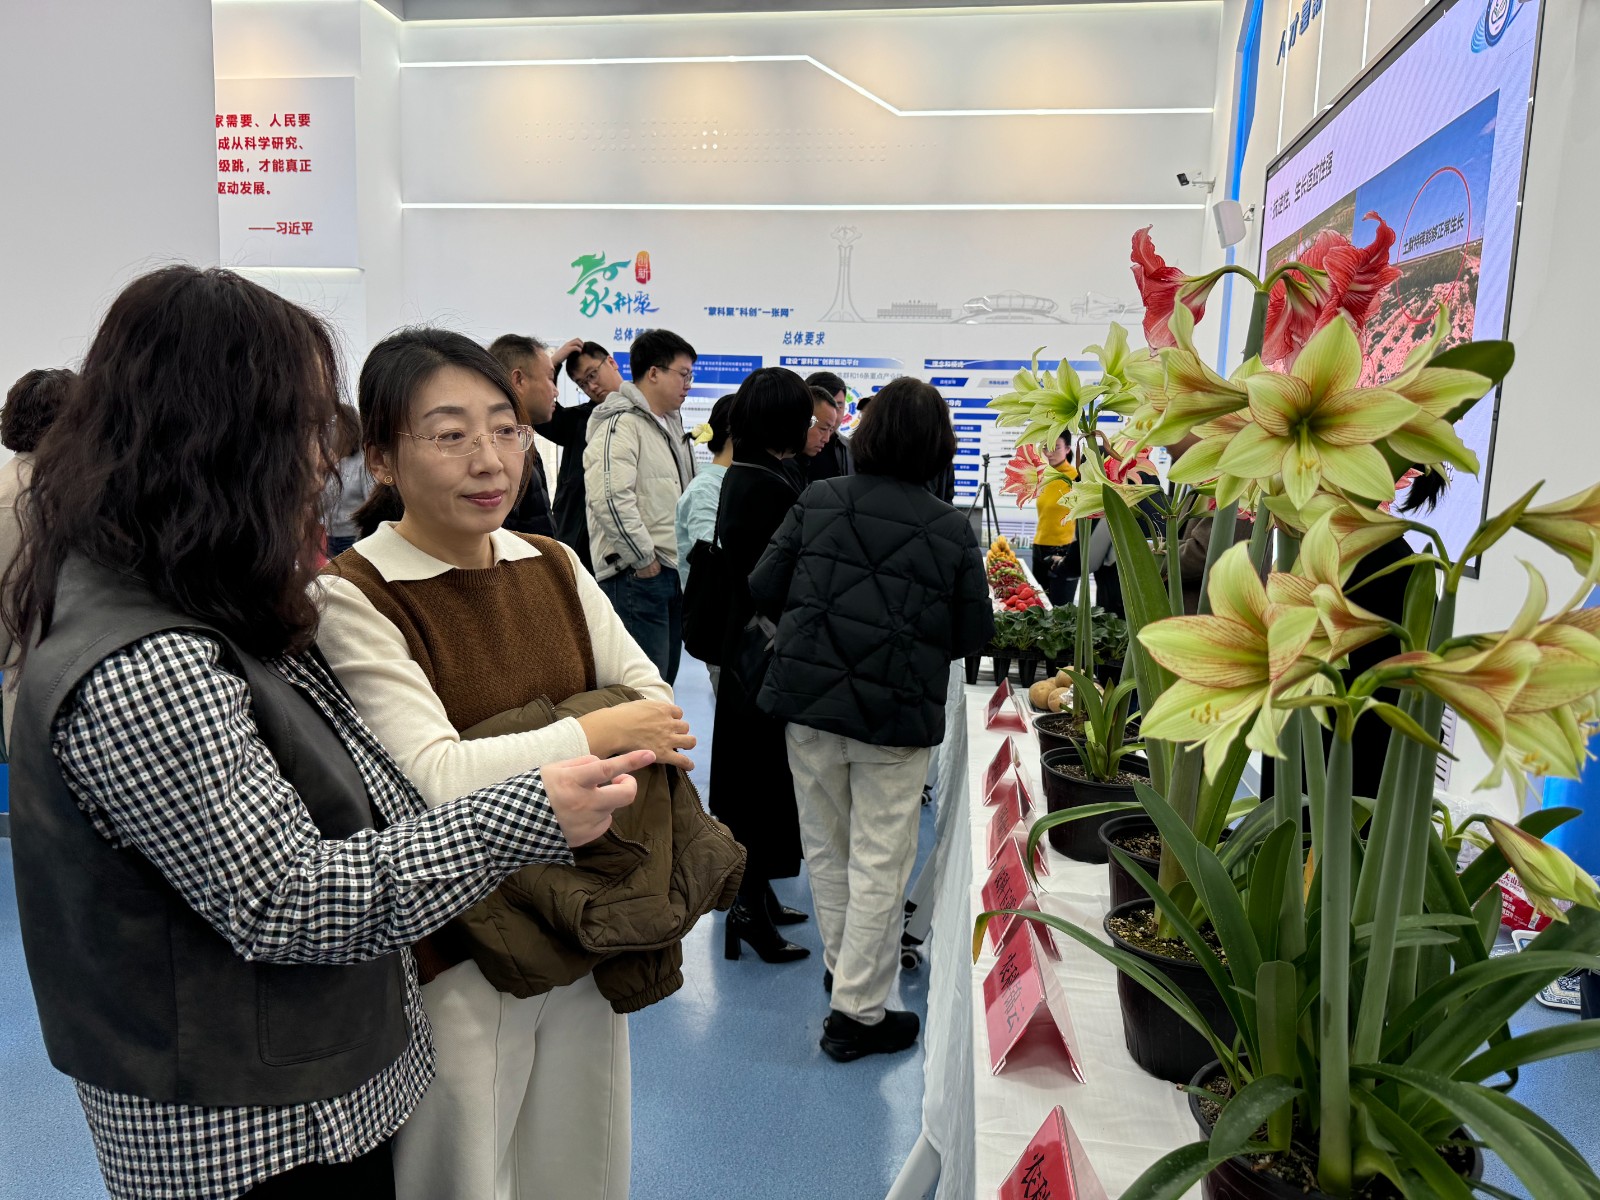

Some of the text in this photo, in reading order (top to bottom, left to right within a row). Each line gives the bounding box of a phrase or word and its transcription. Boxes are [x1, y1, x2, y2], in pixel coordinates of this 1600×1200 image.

[218, 136, 305, 150] 成从科学研究、
[218, 159, 312, 173] 级跳，才能真正
[248, 222, 313, 235] ——习近平
[782, 331, 826, 345] 总体要求
[999, 952, 1025, 1034] 农科锦云
